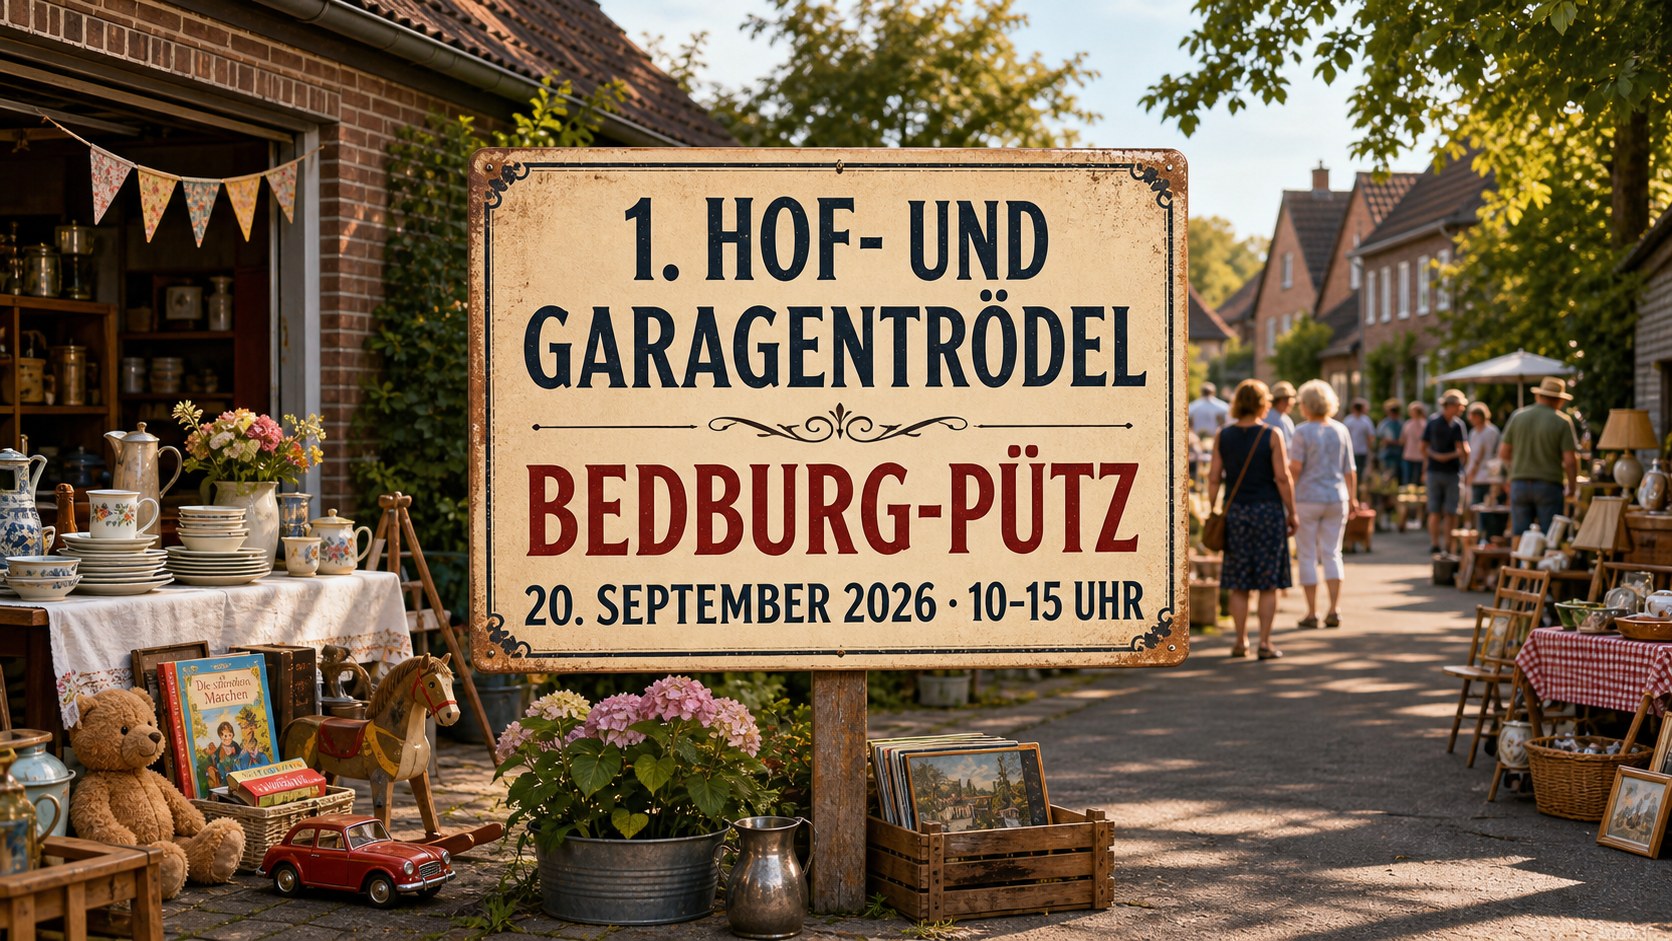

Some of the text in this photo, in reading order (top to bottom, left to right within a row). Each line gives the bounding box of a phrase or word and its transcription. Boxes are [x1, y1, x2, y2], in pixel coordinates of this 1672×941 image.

[624, 196, 1049, 282] 1. HOF- UND
[523, 289, 1147, 390] GARAGENTRÖDEL
[525, 444, 1139, 557] BEDBURG-PÜTZ
[524, 584, 584, 627] 20.
[596, 583, 832, 626] SEPTEMBER
[843, 581, 937, 623] 2026
[1074, 580, 1145, 621] UHR
